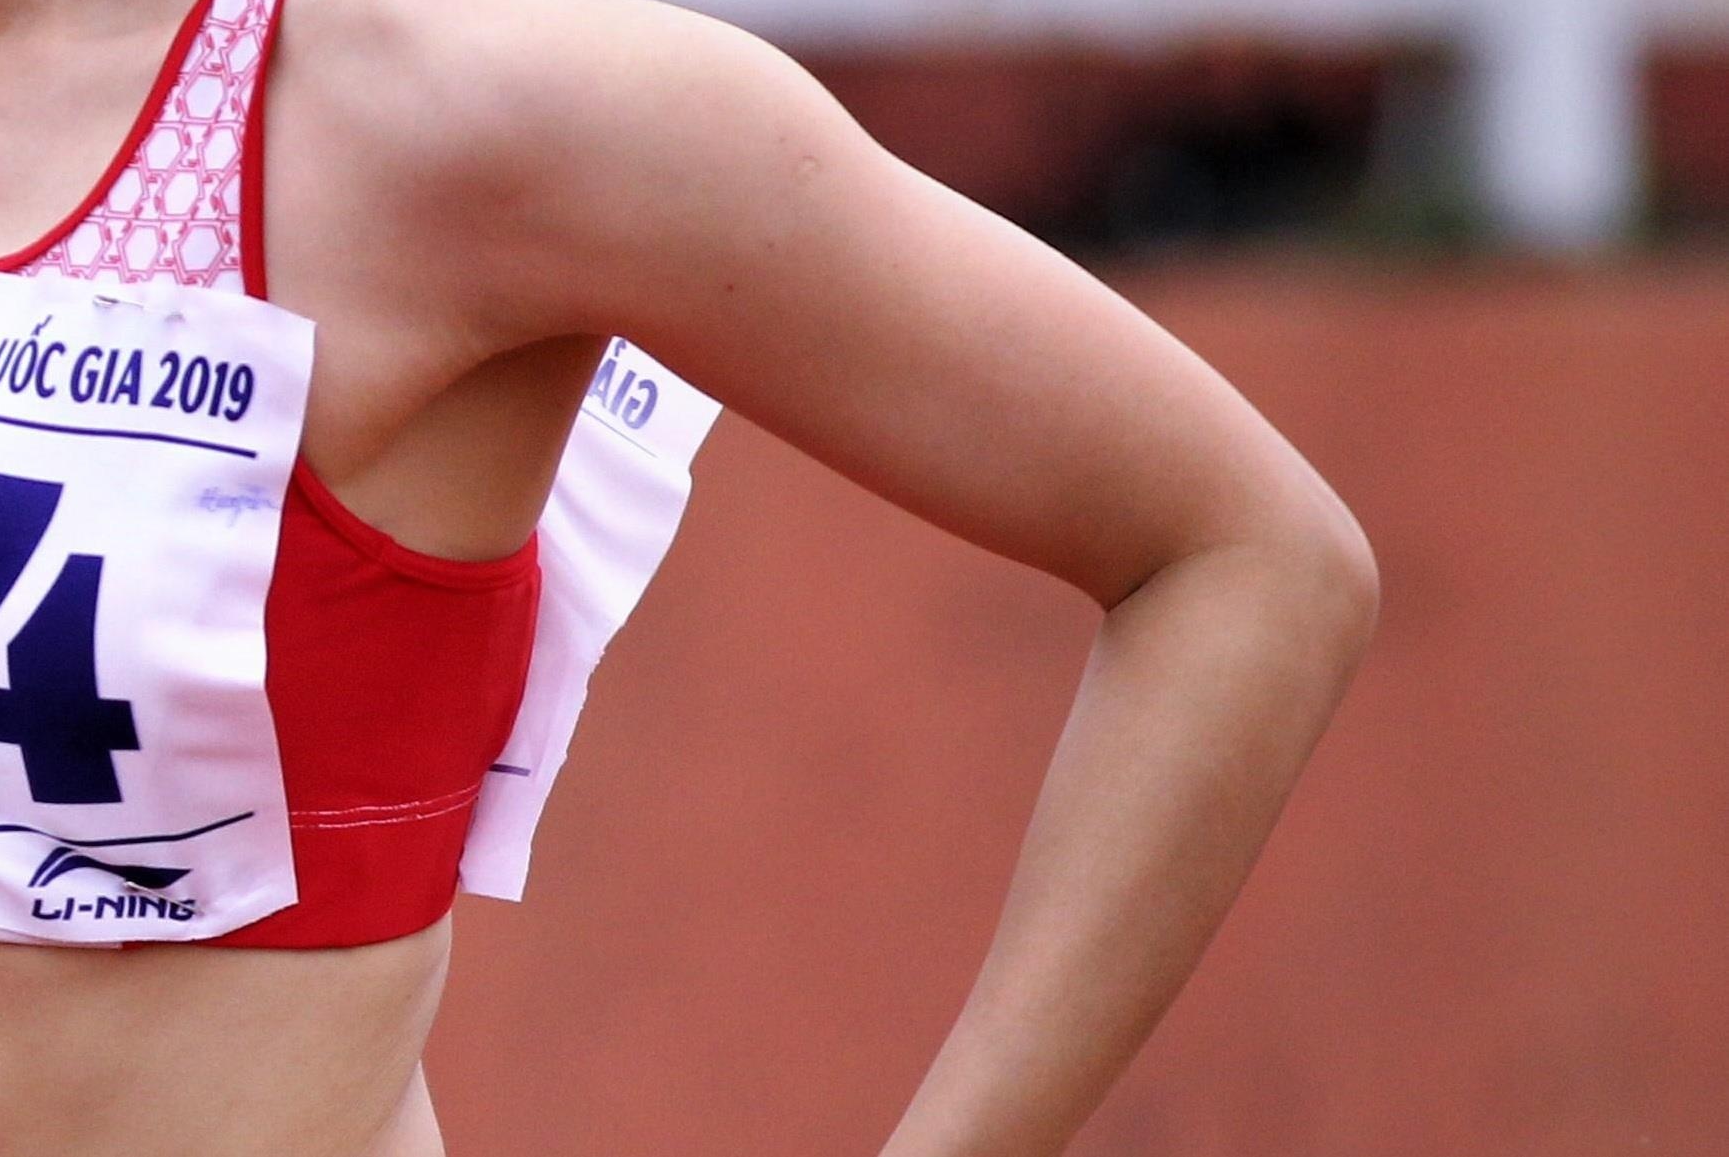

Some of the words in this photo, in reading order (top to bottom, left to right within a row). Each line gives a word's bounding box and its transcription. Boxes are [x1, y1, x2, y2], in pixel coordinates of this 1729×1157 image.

[70, 347, 144, 405] GIA
[150, 351, 255, 422] 2019
[31, 896, 196, 921] LI-NING
